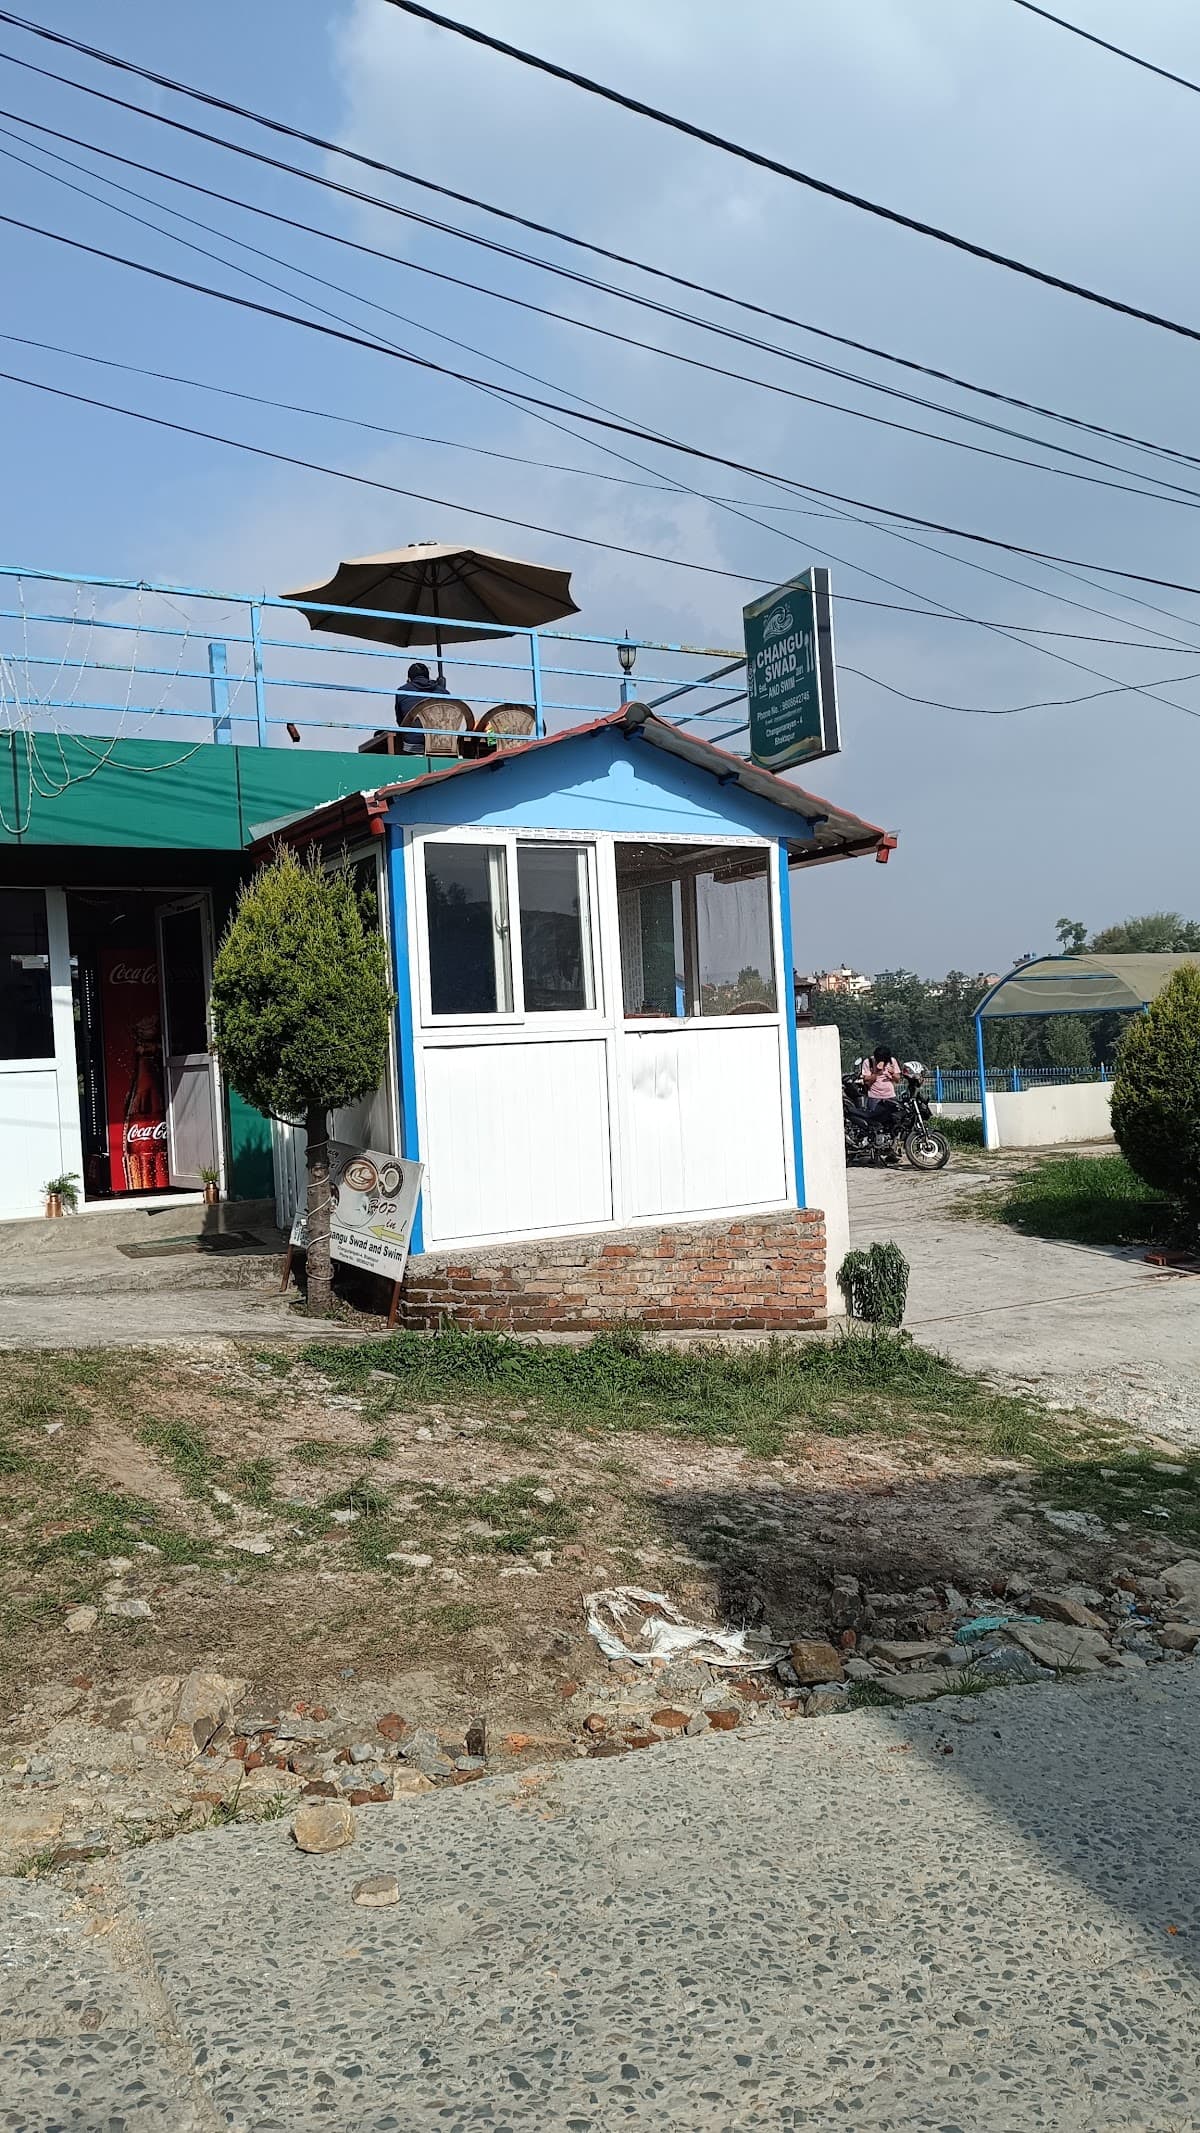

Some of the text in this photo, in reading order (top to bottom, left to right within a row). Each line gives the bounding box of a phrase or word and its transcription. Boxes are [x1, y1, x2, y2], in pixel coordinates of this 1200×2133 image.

[757, 630, 803, 669] CHANGU
[765, 653, 797, 683] SWAD
[768, 676, 796, 699] AND SWIM
[330, 1231, 348, 1244] angu
[349, 1234, 368, 1250] Swad
[368, 1243, 382, 1255] and
[383, 1246, 403, 1262] Swim
